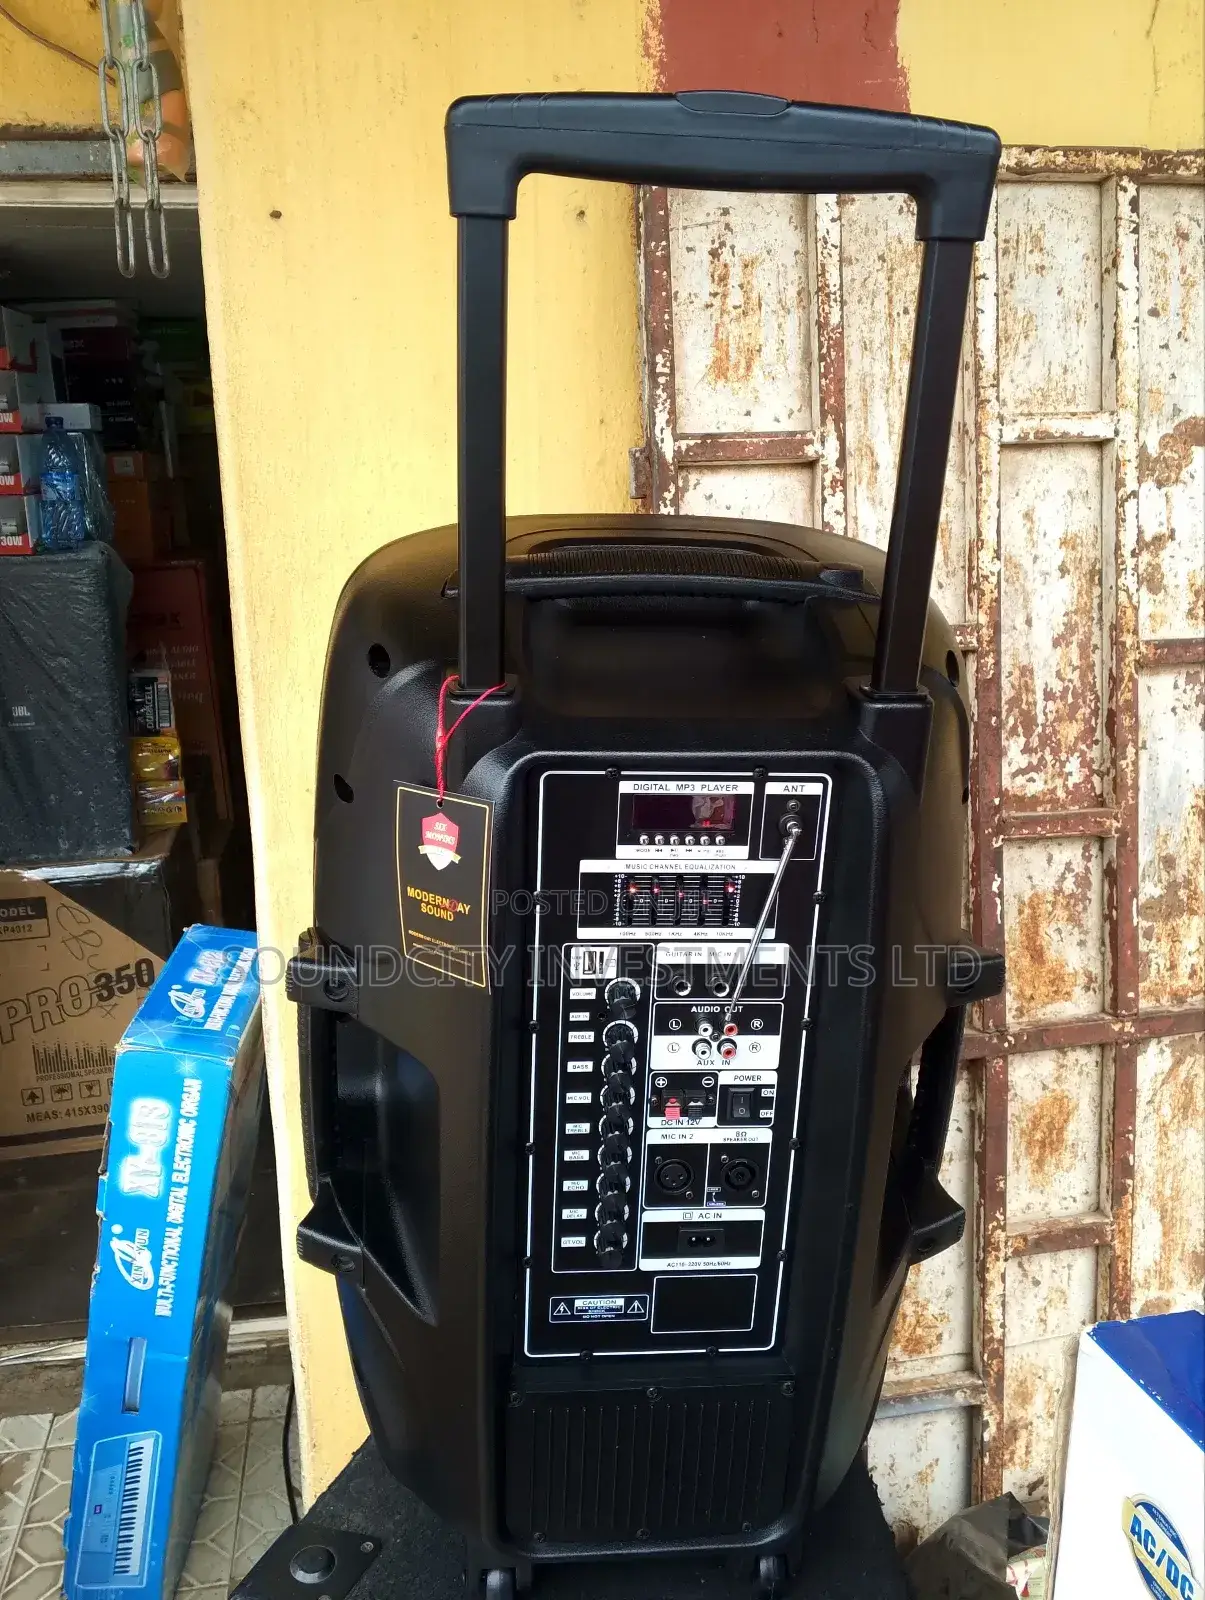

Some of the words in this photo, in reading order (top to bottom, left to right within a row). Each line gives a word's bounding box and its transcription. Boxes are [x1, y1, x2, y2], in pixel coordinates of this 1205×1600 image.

[11, 705, 31, 717] JBL
[633, 783, 671, 792] DIGITAL
[675, 784, 696, 792] MP3
[700, 784, 739, 792] PLAYER
[783, 784, 806, 793] ANT
[421, 902, 454, 922] SOUND
[92, 957, 156, 1002] 350
[691, 1005, 720, 1013] AUDIO
[36, 1072, 83, 1082] PROFESSIONAL
[733, 1074, 762, 1082] POWER
[179, 1077, 203, 1118] ORGAN
[26, 1109, 62, 1123] MEAS:
[64, 1103, 110, 1118] 415X390
[172, 1118, 197, 1184] ELECTRONIC
[166, 1185, 189, 1224] DIGITAL
[137, 1229, 149, 1254] YUN
[131, 1264, 144, 1284] XIN
[155, 1226, 184, 1317] MULTI-FUNCTIONAL
[1129, 1513, 1195, 1600] AC/DC
